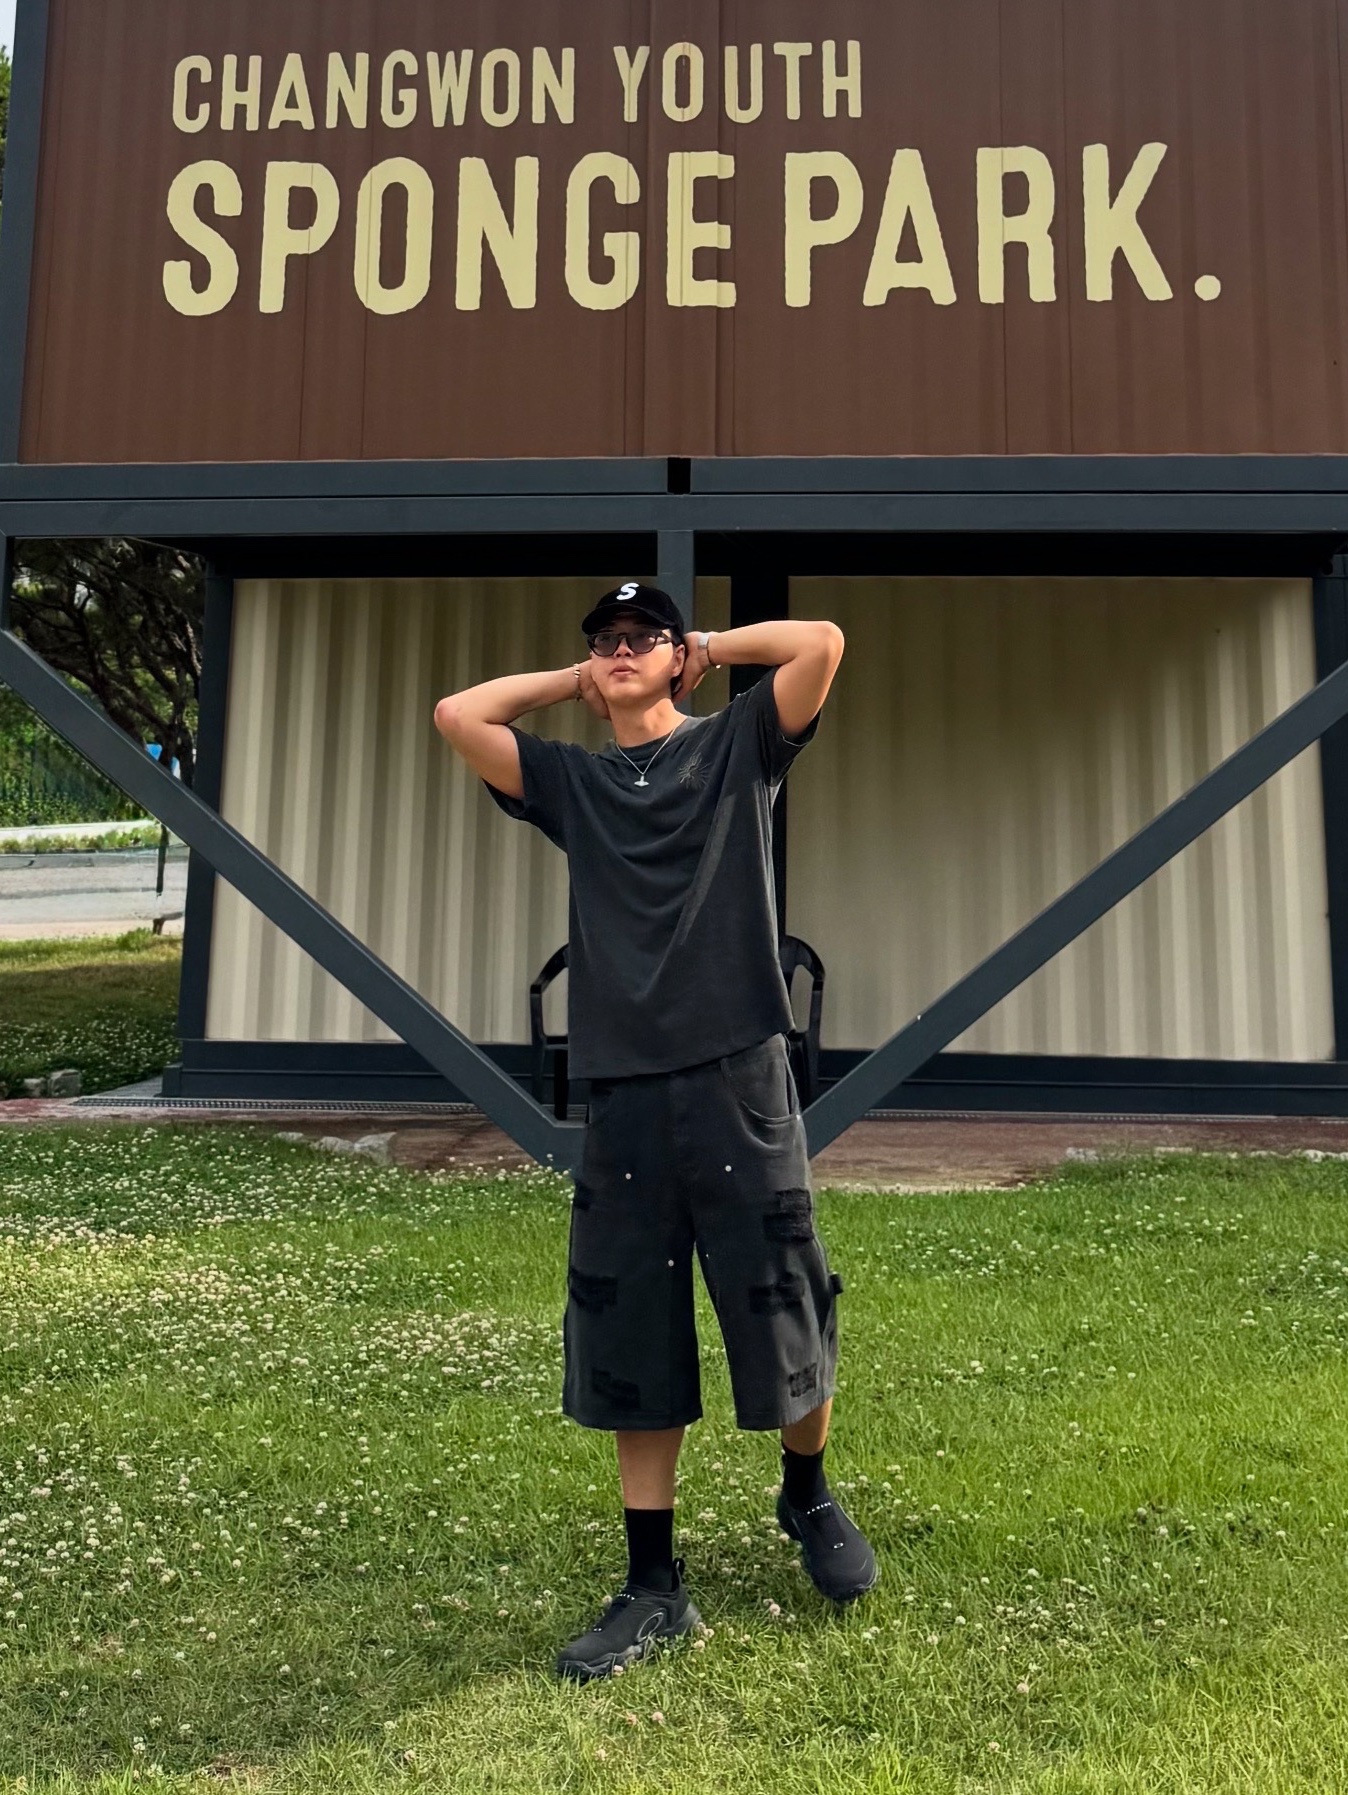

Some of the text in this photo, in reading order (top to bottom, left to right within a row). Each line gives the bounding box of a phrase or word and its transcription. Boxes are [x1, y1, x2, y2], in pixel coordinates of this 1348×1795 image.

[172, 39, 862, 133] CHANGWON YOUTH
[162, 142, 1222, 317] SPONGE PARK.
[616, 582, 640, 601] S
